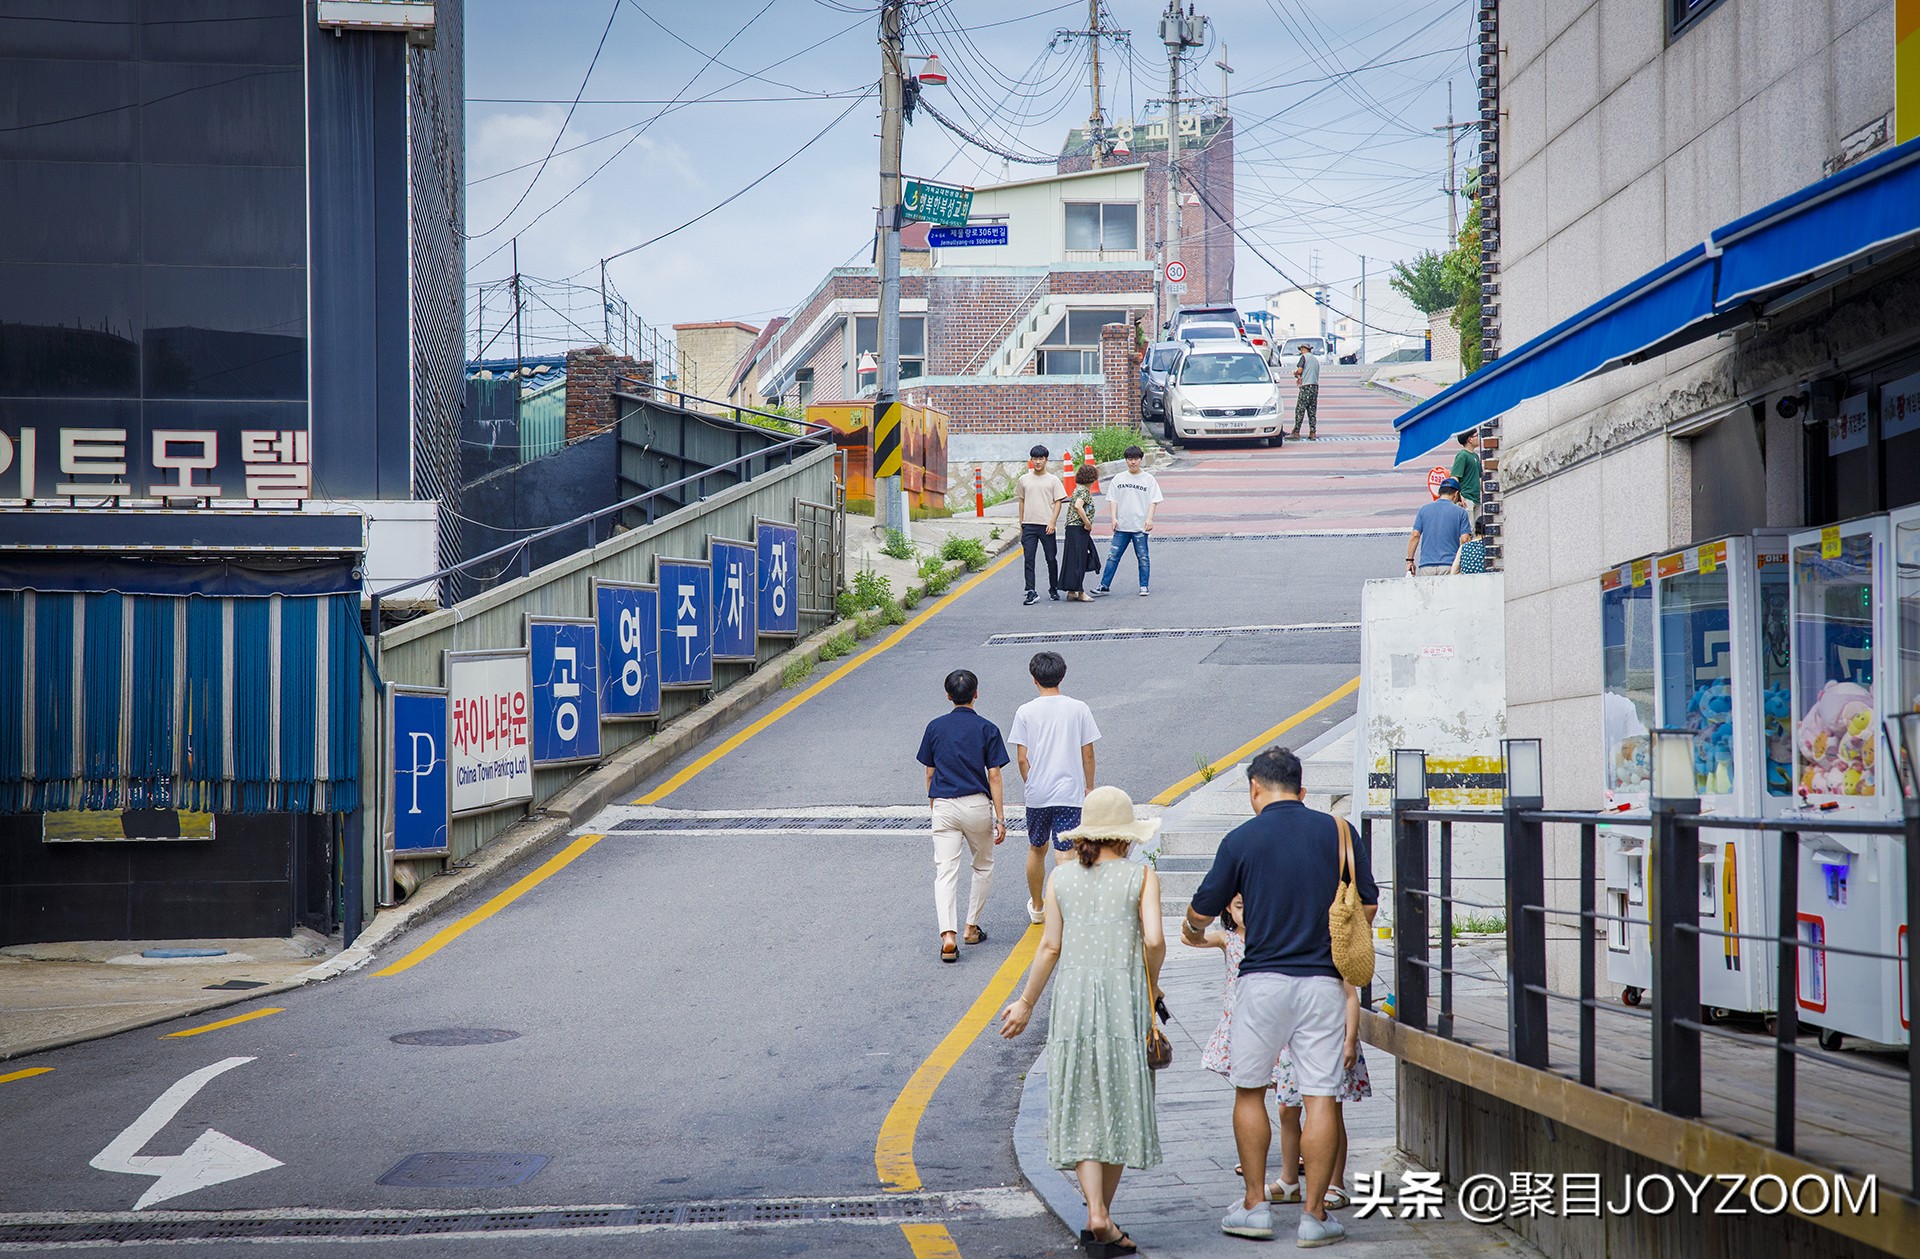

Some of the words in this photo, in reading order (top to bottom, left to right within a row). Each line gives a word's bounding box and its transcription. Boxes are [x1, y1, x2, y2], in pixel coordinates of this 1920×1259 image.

[919, 193, 970, 220] 행복한북성교회
[1169, 266, 1183, 277] 30
[727, 562, 744, 640] 차
[771, 543, 788, 617] 장
[619, 608, 642, 697] 영
[677, 584, 698, 665] 주
[453, 691, 527, 756] 차이나타운
[553, 647, 580, 742] 공
[408, 732, 436, 814] P
[456, 766, 477, 787] (China
[477, 763, 494, 781] Town
[494, 759, 515, 779] Parking
[515, 755, 527, 774] Lot)
